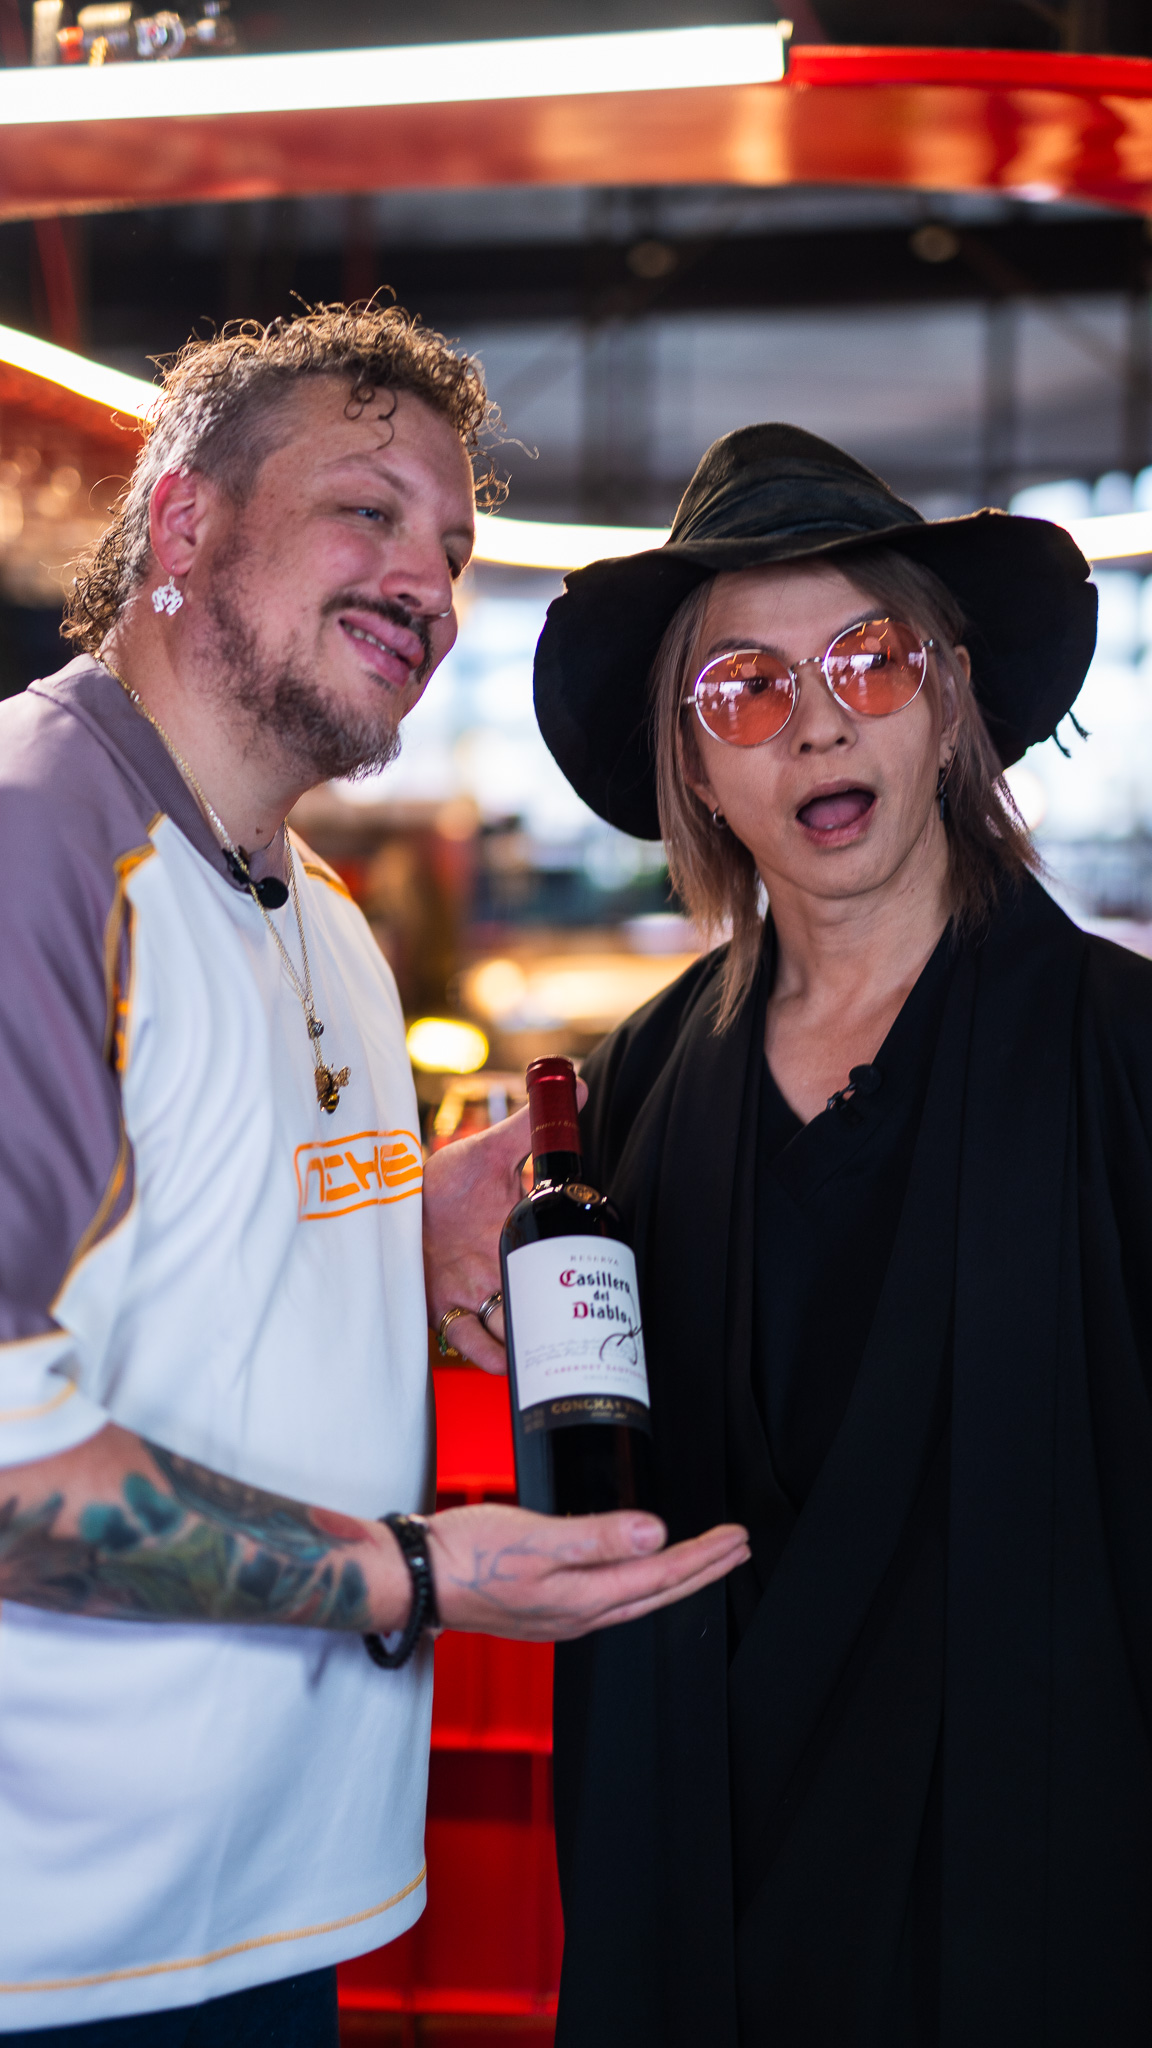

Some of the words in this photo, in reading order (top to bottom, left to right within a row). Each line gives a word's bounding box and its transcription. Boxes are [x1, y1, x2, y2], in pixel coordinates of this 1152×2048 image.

[570, 1254, 619, 1267] RESERVA
[559, 1268, 631, 1294] Casillero
[593, 1289, 610, 1302] del
[572, 1300, 627, 1323] Diablo
